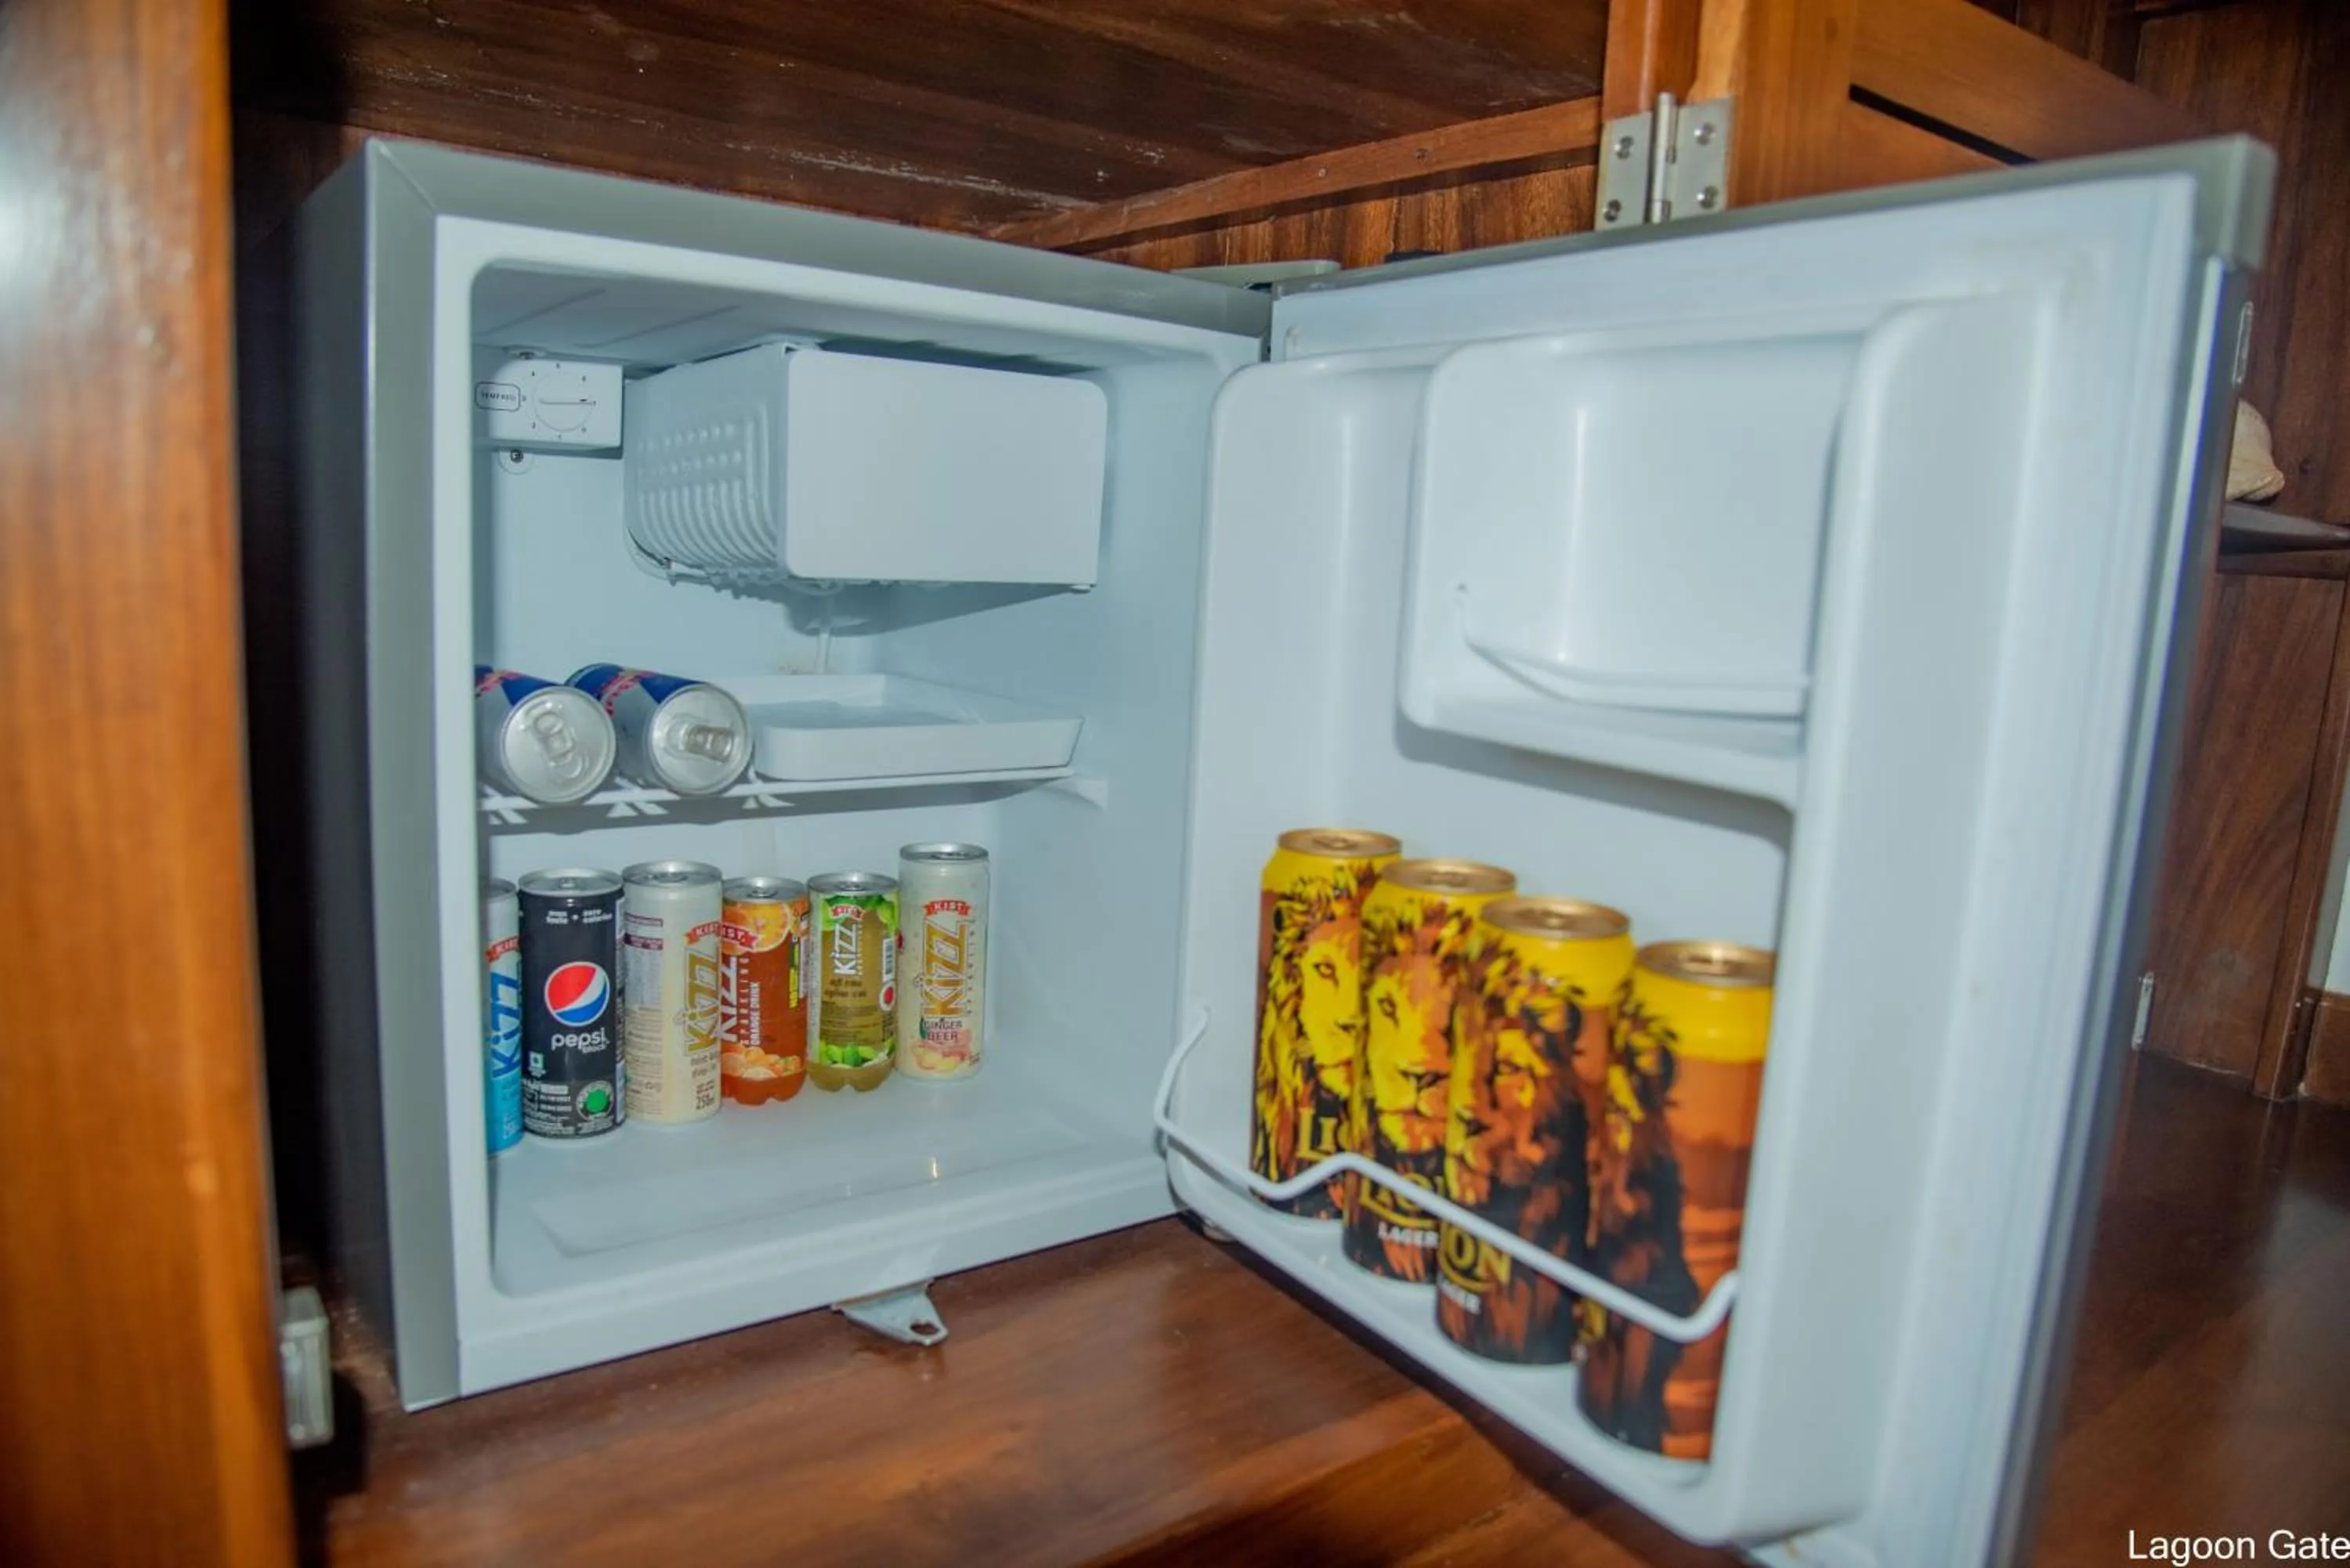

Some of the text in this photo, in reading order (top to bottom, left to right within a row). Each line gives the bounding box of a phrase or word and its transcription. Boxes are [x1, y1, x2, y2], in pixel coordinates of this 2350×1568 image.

[551, 1027, 606, 1051] pepsi
[927, 1031, 959, 1042] BEER
[1378, 1220, 1439, 1247] LAGER
